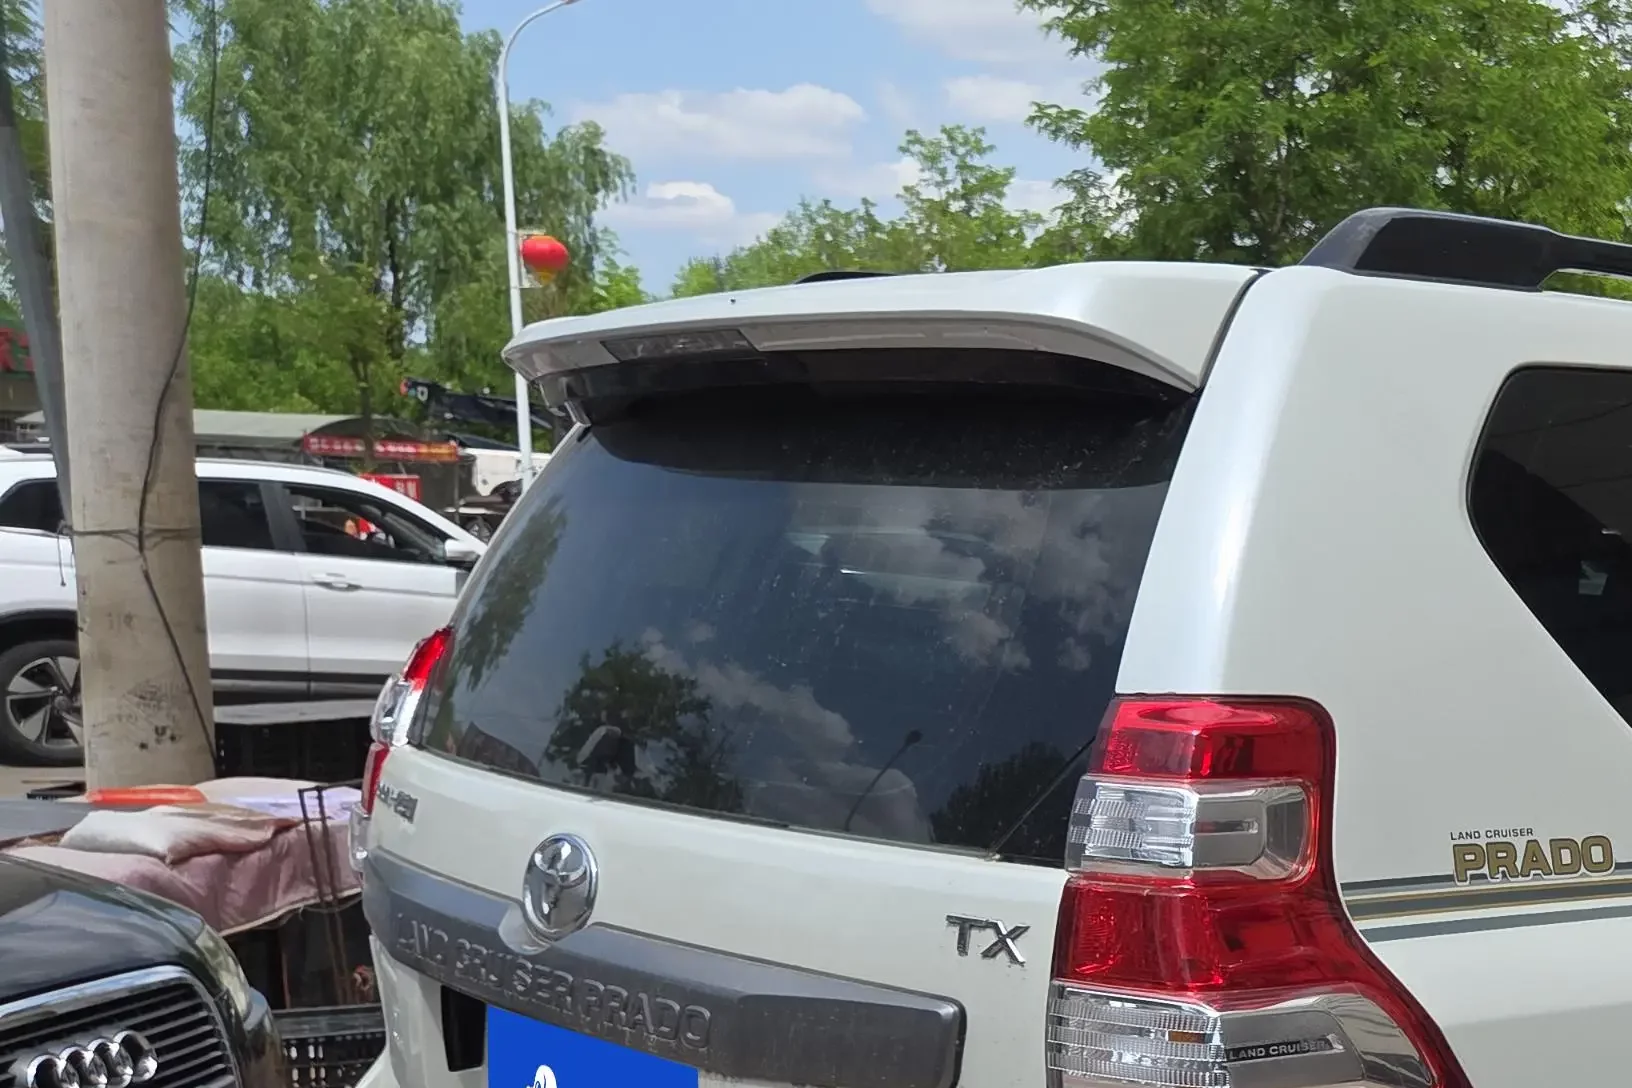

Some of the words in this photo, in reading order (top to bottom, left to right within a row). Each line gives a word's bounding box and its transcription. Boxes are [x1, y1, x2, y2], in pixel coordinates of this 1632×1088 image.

[1450, 830, 1481, 841] LAND
[1485, 827, 1534, 839] CRUISER
[1452, 834, 1615, 885] PRADO
[945, 913, 1030, 967] TX
[578, 976, 712, 1052] PRADO
[1229, 1046, 1265, 1061] LAND
[1268, 1039, 1329, 1056] CRUISER
